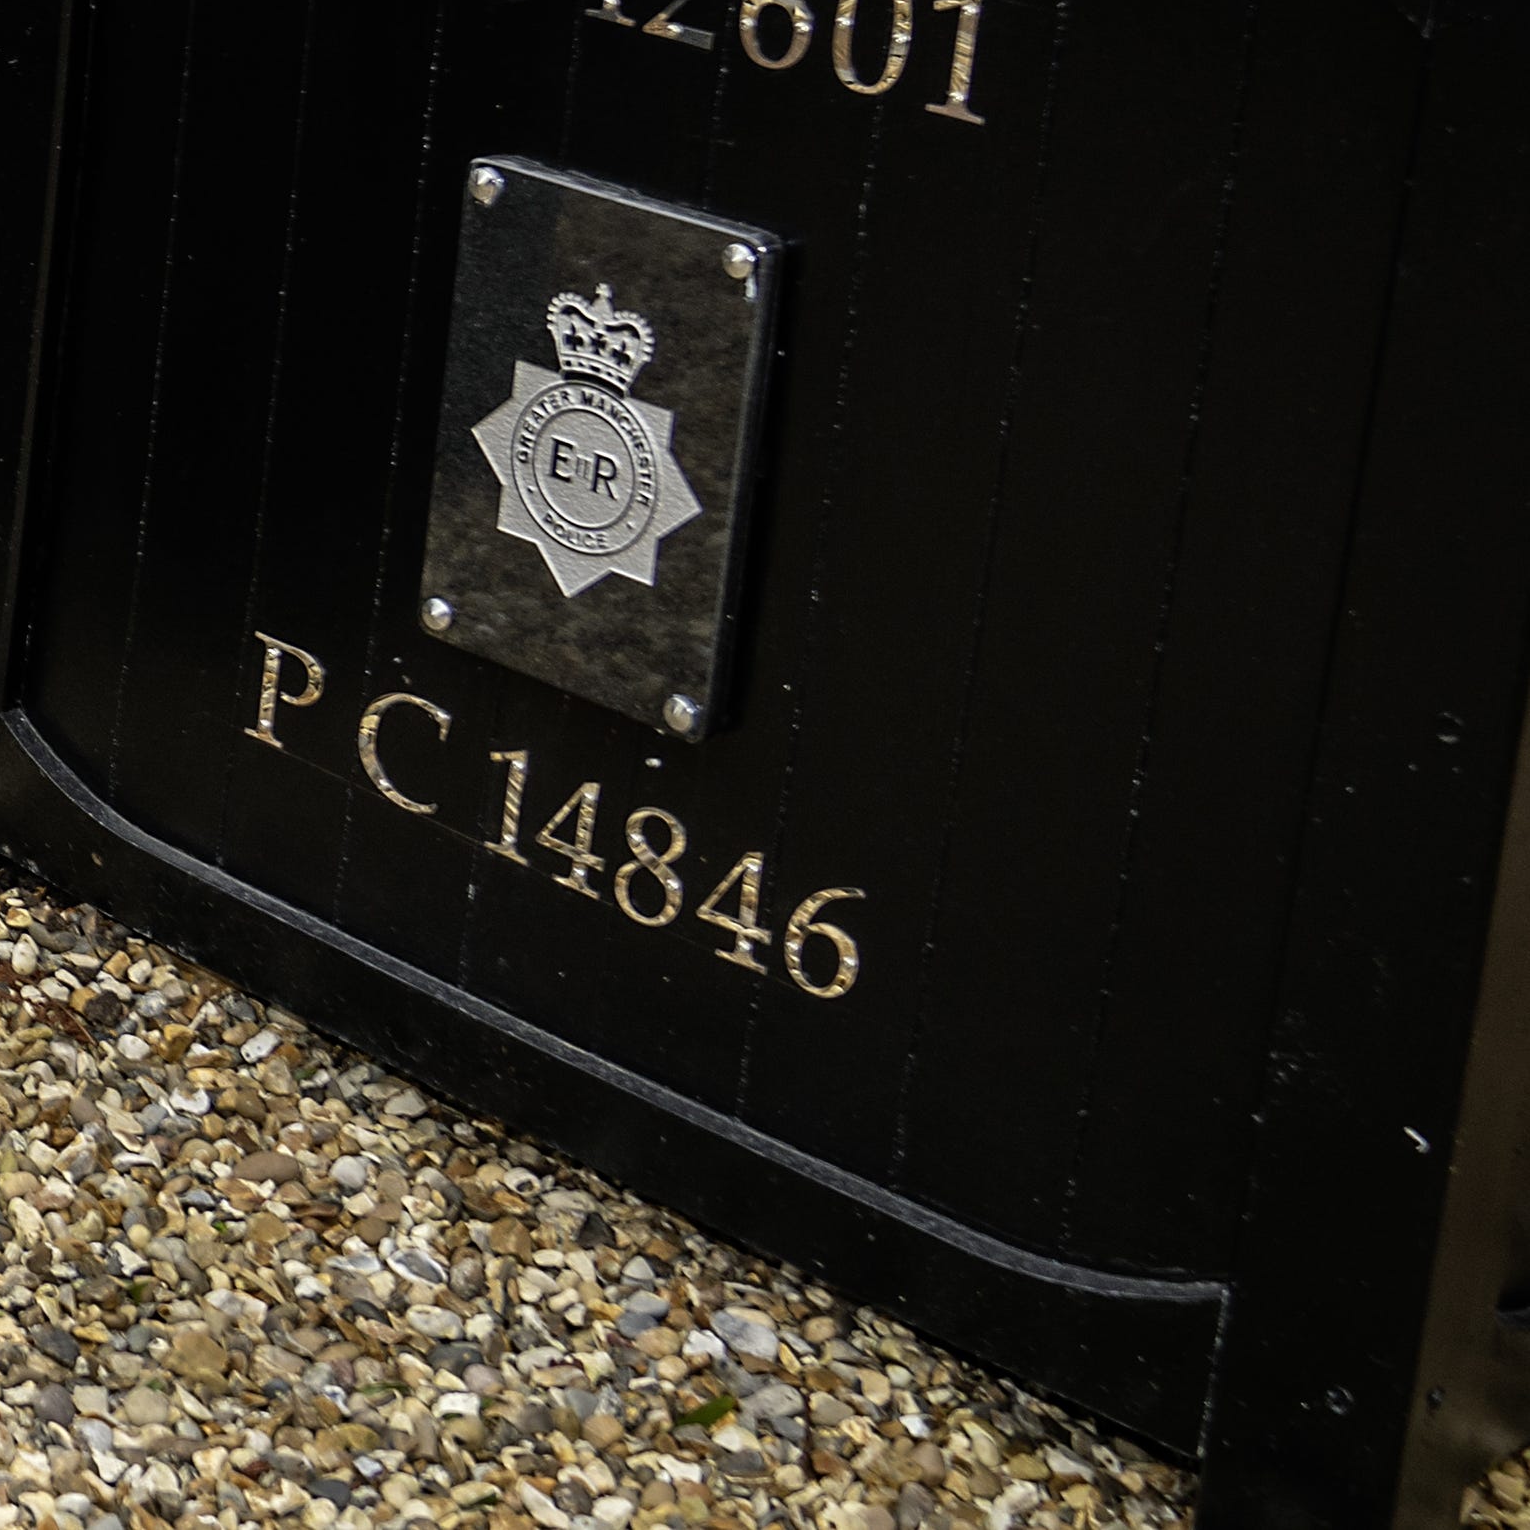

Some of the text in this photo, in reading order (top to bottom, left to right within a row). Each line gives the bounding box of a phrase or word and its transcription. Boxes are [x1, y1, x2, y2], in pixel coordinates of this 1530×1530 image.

[515, 389, 658, 508] GREATER MANCHESTER
[541, 511, 609, 551] POLICE
[483, 749, 867, 1000] 14846
